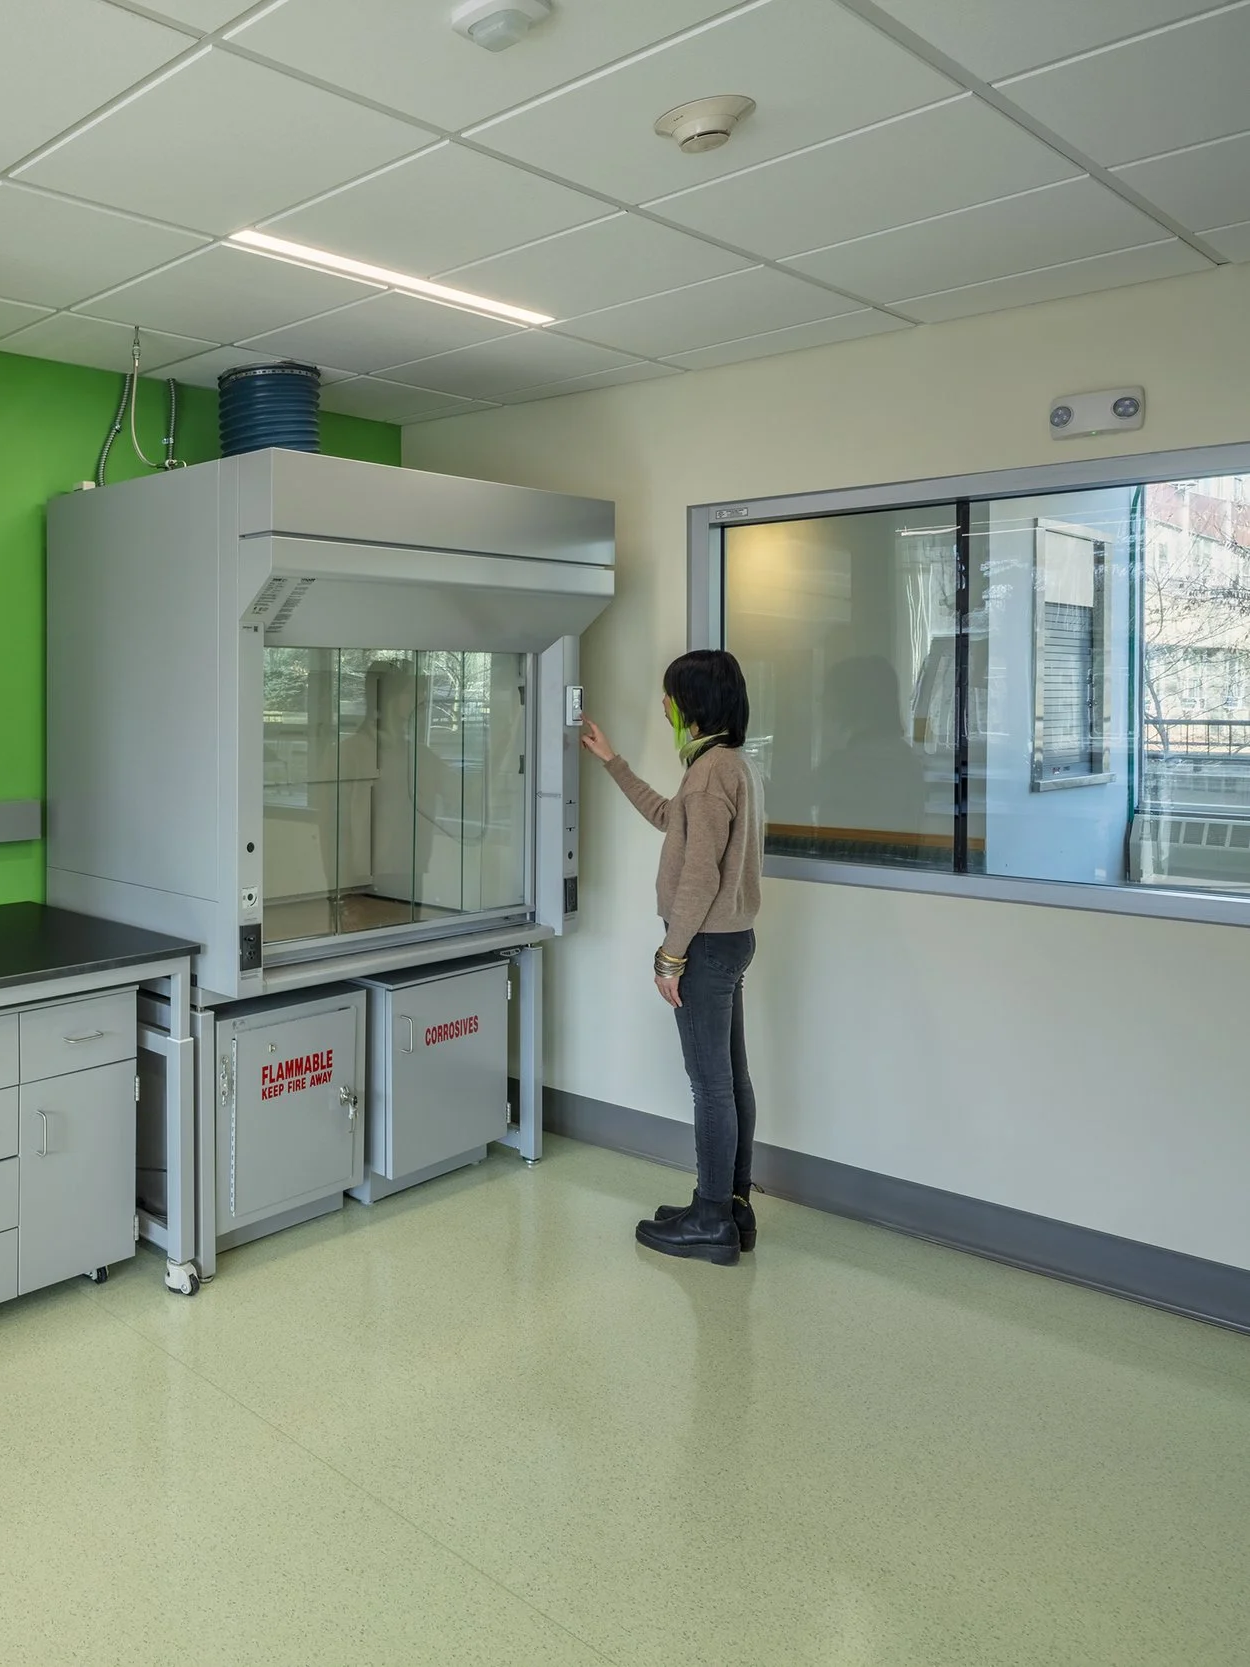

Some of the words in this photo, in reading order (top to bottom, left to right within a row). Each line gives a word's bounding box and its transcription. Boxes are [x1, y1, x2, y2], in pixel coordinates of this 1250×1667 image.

[425, 1015, 479, 1046] CORROSIVES
[261, 1049, 333, 1086] FLAMMABLE
[261, 1083, 284, 1100] KEEP
[287, 1077, 307, 1093] FIRE
[309, 1070, 333, 1089] AWAY
